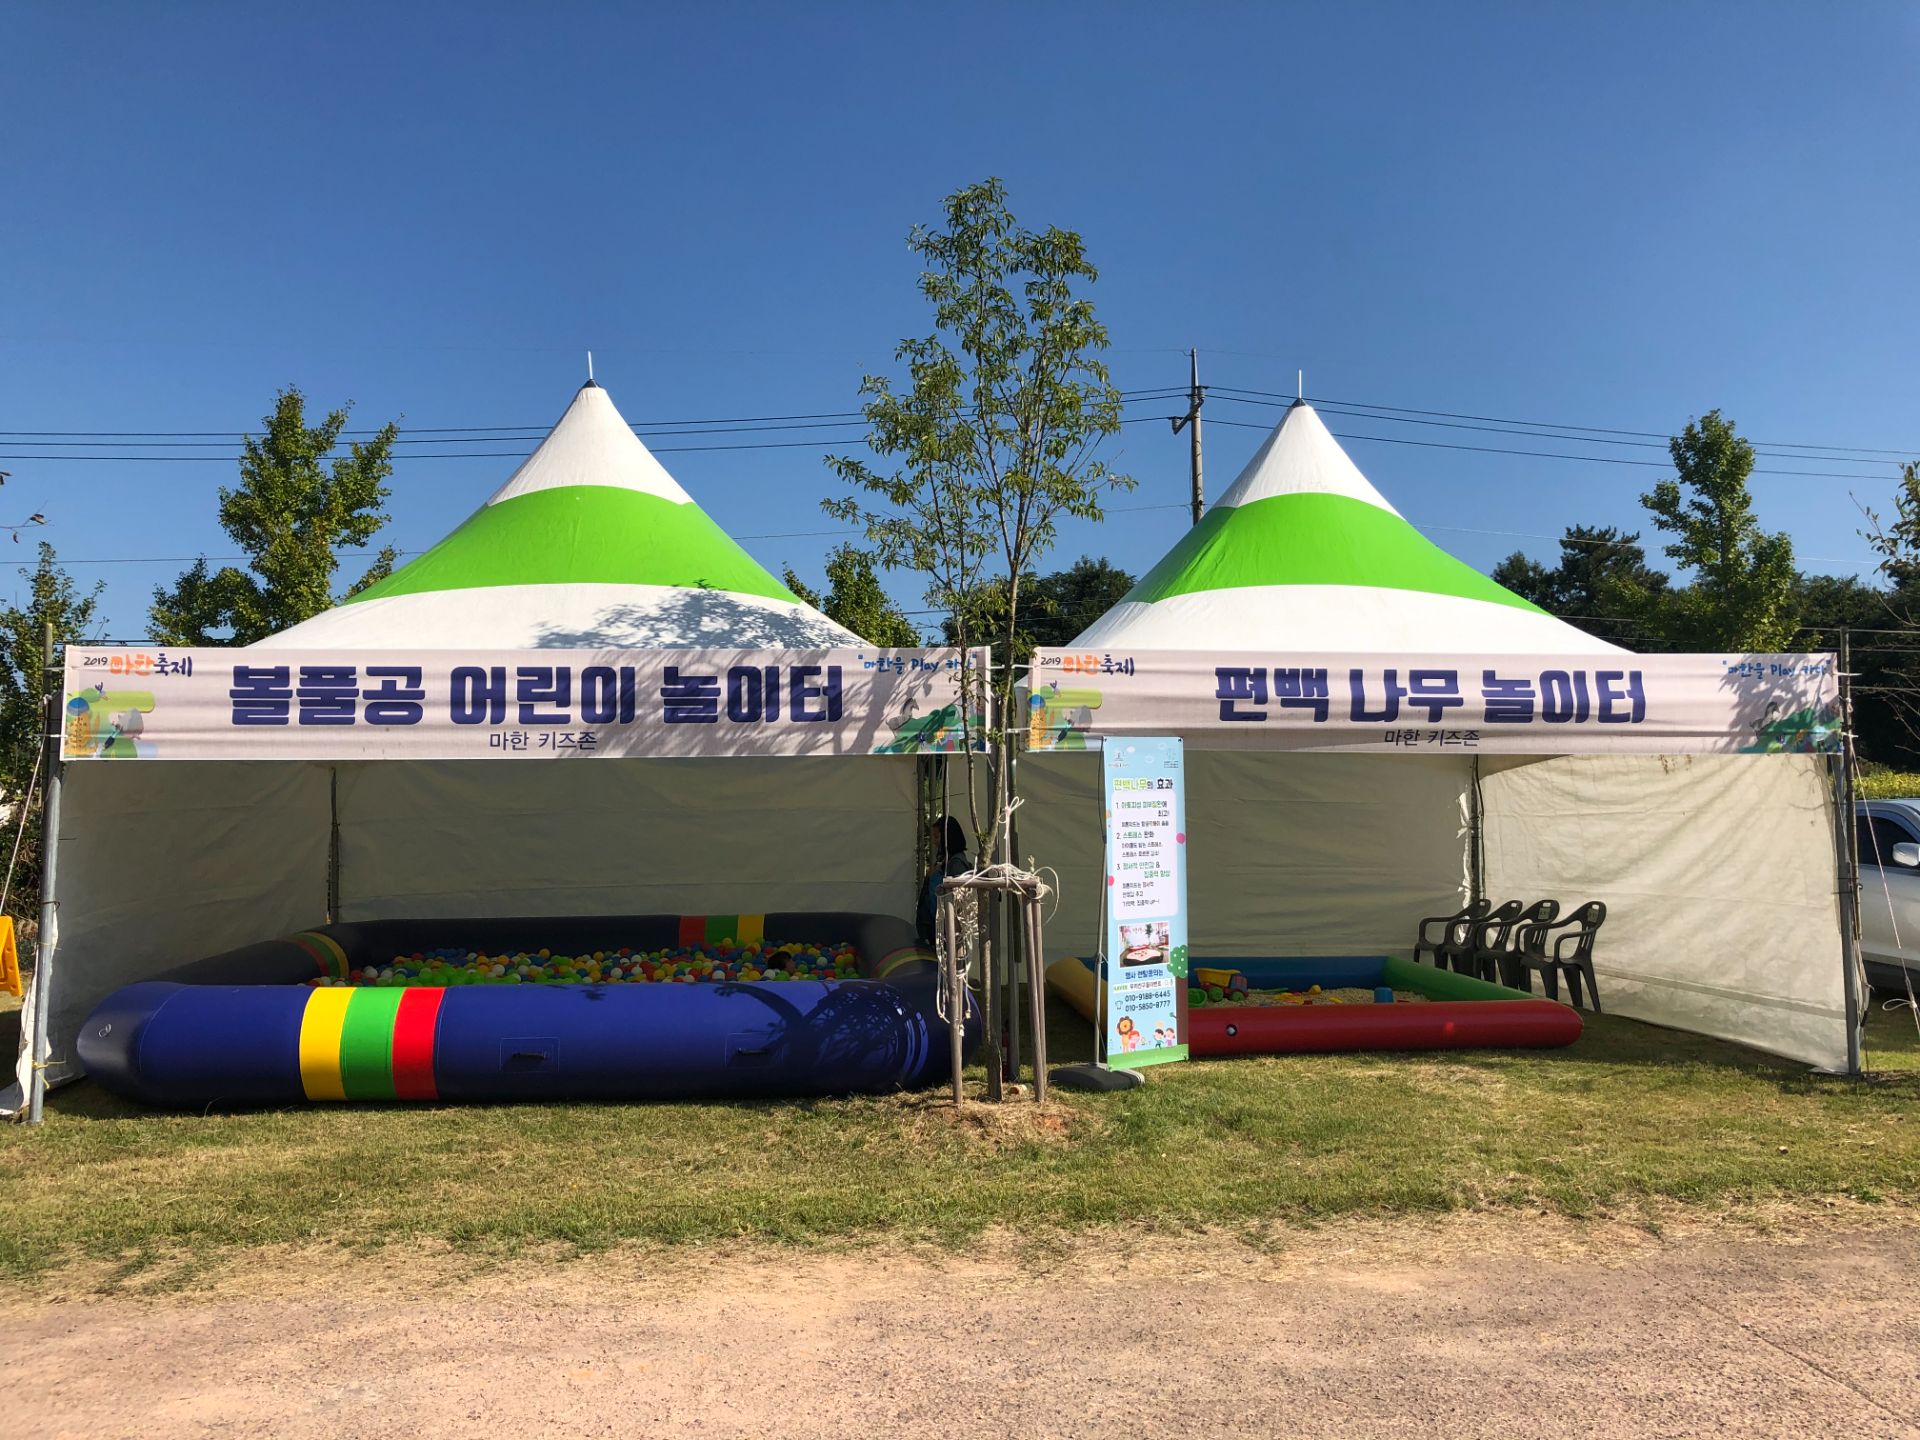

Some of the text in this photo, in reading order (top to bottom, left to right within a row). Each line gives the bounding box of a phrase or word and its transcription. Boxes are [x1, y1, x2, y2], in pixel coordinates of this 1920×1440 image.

[83, 655, 108, 666] 2019
[911, 656, 939, 673] Play
[1040, 657, 1061, 666] 2019
[1770, 663, 1796, 678] Play
[229, 665, 843, 725] 볼풀공 어린이 놀이터
[1481, 670, 1646, 724] 놀이터
[489, 731, 597, 750] 마한 키즈존
[1384, 729, 1480, 747] 마한 키즈존
[1114, 778, 1173, 791] 편백나무의 효과
[1123, 831, 1142, 839] 스트레스
[1125, 971, 1136, 980] 행사
[1125, 990, 1171, 1002] 010-9188-6445
[1125, 1000, 1171, 1012] 010-5850-8777
